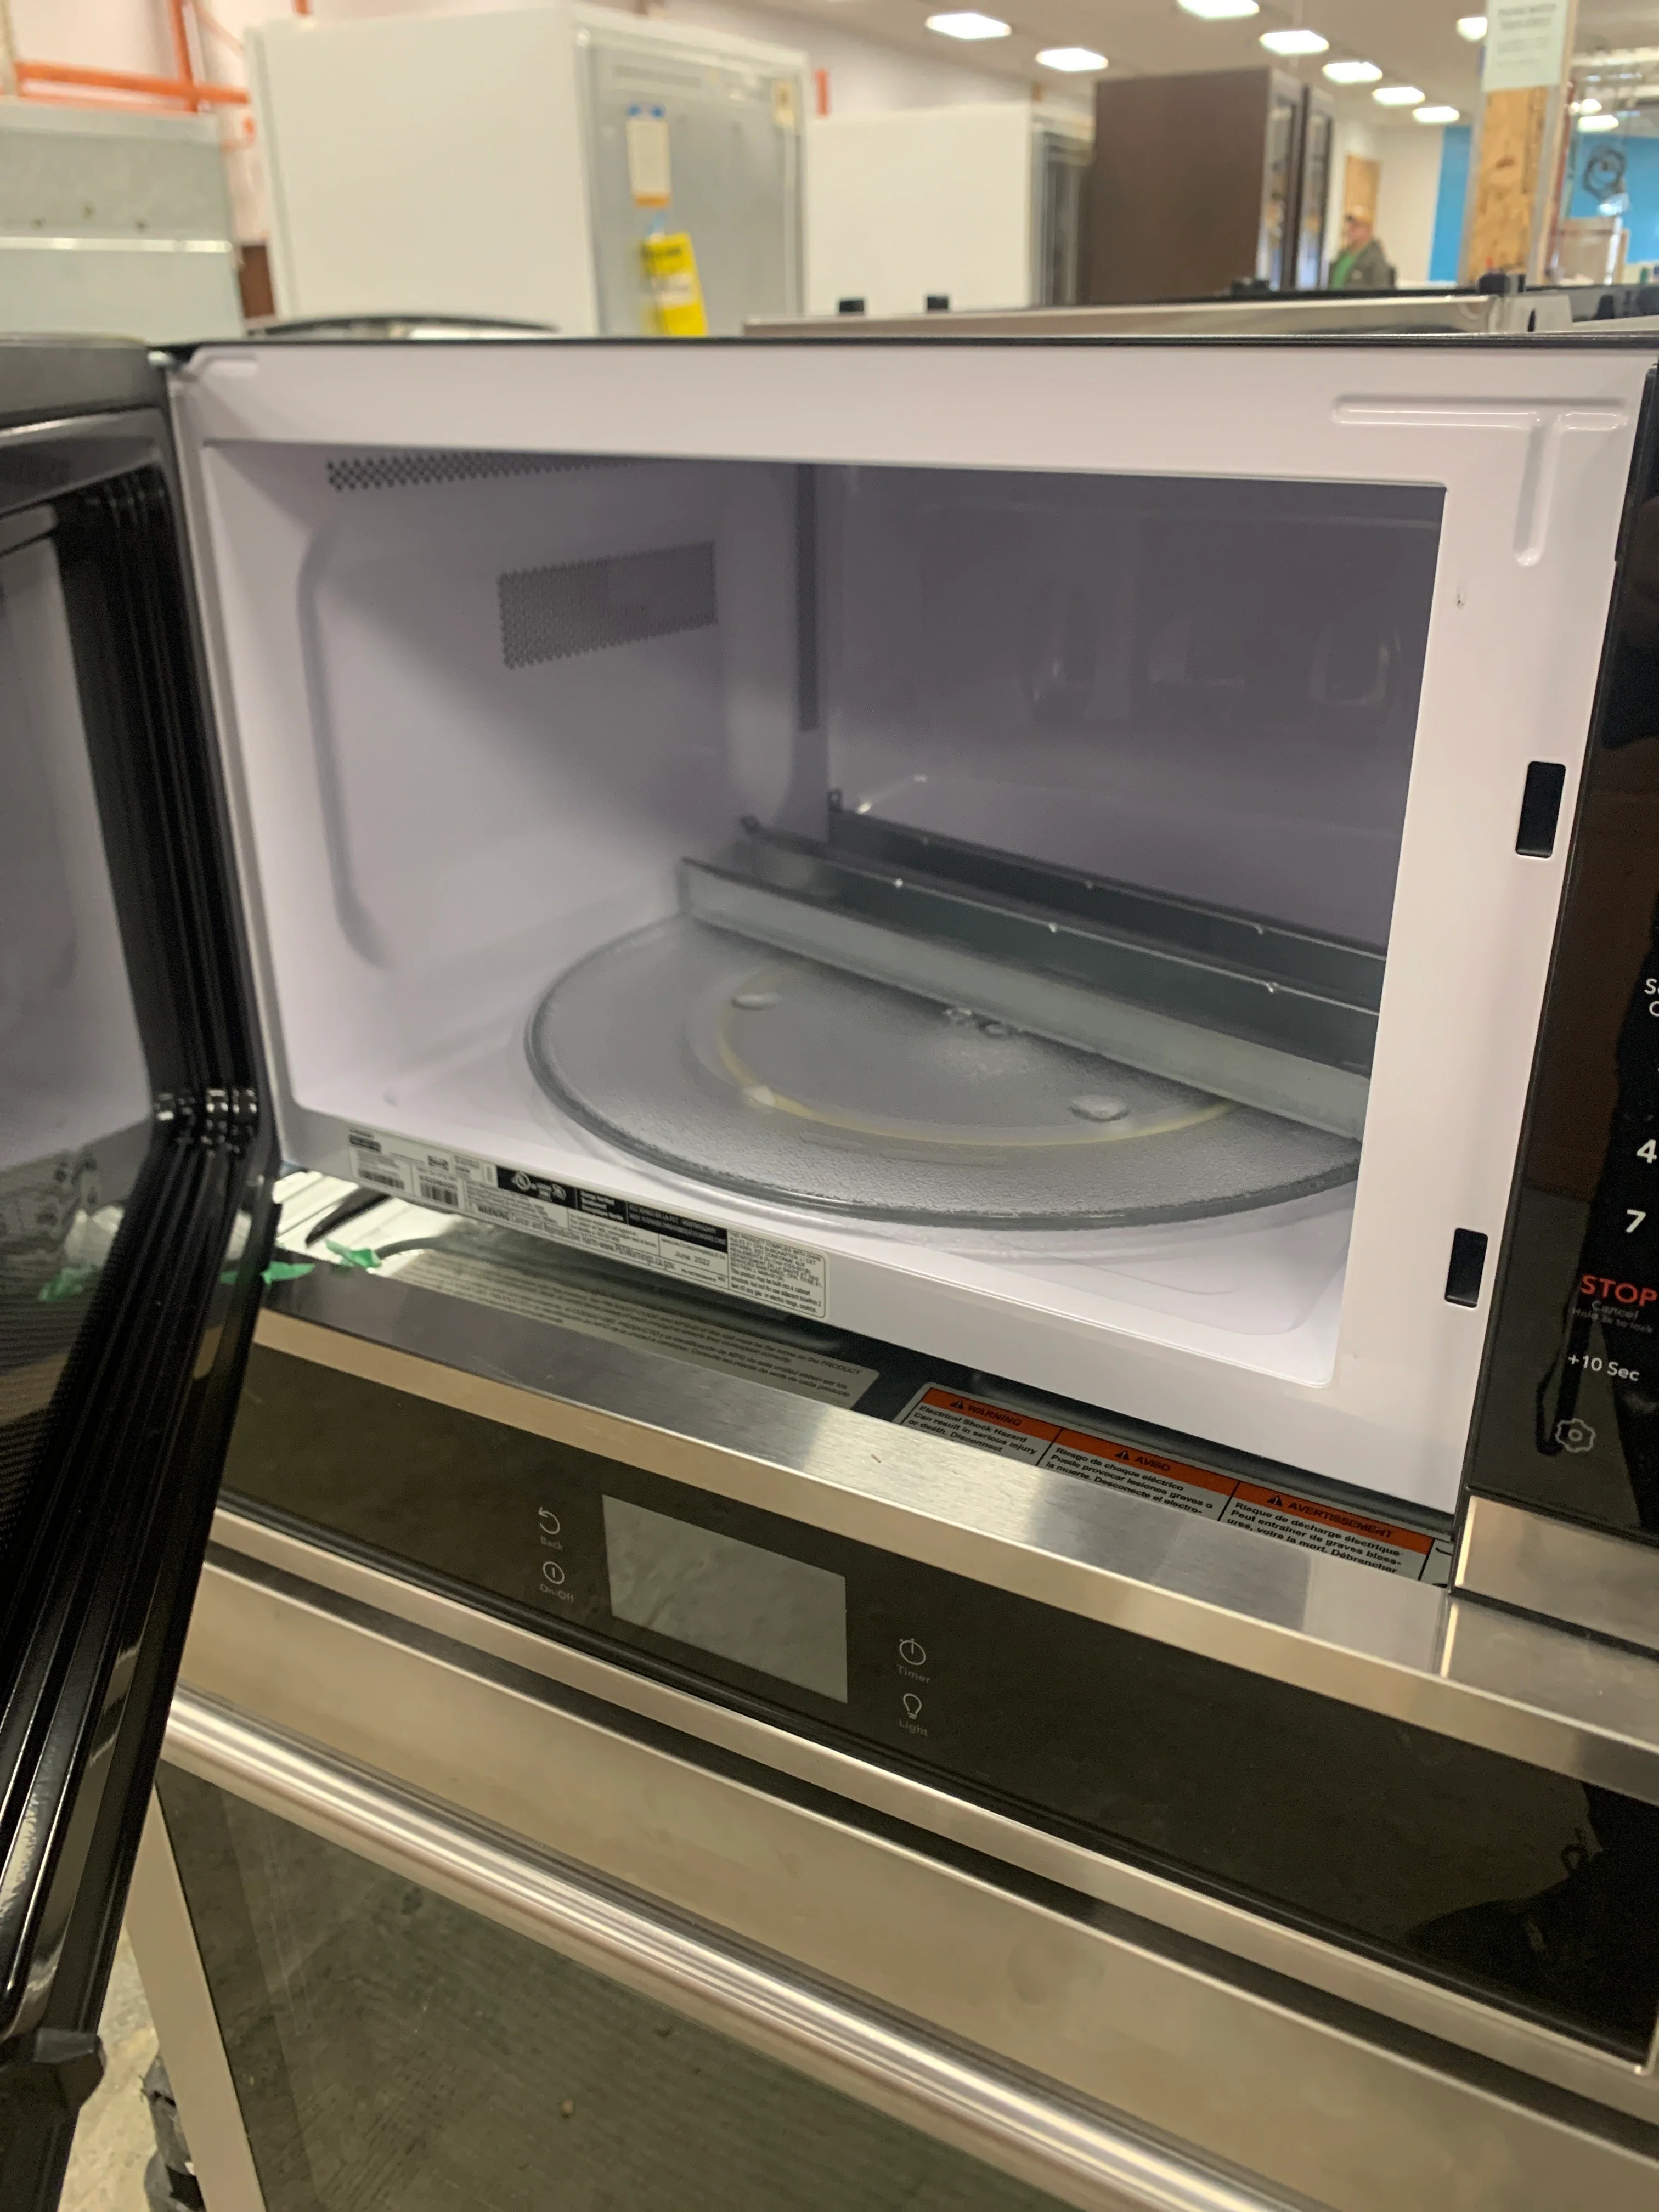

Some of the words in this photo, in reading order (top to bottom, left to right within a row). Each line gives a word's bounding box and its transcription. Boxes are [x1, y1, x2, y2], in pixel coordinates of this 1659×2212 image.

[1637, 1139, 1657, 1164] 4
[1626, 1209, 1646, 1233] 7
[1581, 1274, 1658, 1307] STOP
[1567, 1354, 1602, 1372] +10
[1606, 1361, 1640, 1381] Sec
[919, 1406, 961, 1422] Electrical
[964, 1419, 991, 1432] Shock
[994, 1427, 1028, 1443] Hazard
[968, 1404, 1022, 1426] WARNING
[913, 1412, 930, 1422] Can
[933, 1418, 961, 1431] result
[972, 1430, 1007, 1445] serious
[1009, 1441, 1037, 1455] injury
[919, 1422, 947, 1435] death.
[950, 1431, 1003, 1453] Disconnect
[1056, 1447, 1089, 1462] Riesgo
[1091, 1458, 1102, 1466] de
[1104, 1463, 1140, 1478] choque
[1134, 1457, 1171, 1472] AVISO
[1051, 1454, 1080, 1468] Puede
[1082, 1464, 1126, 1482] provocar
[1126, 1478, 1167, 1494] lesiones
[1169, 1491, 1204, 1507] graves
[1056, 1464, 1091, 1480] muerte.
[1094, 1476, 1151, 1499] Desconecte
[1235, 1502, 1273, 1519] Risque
[1276, 1514, 1289, 1522] de
[1288, 1502, 1392, 1538] AVERTISSEMENT
[1231, 1510, 1257, 1522] Peut
[1309, 1534, 1323, 1542] de
[1325, 1539, 1363, 1556] graves
[1256, 1528, 1283, 1541] voire
[1285, 1536, 1296, 1544] la
[1299, 1541, 1328, 1553] mort.
[897, 1665, 930, 1684] Timer
[899, 1719, 929, 1737] Light
